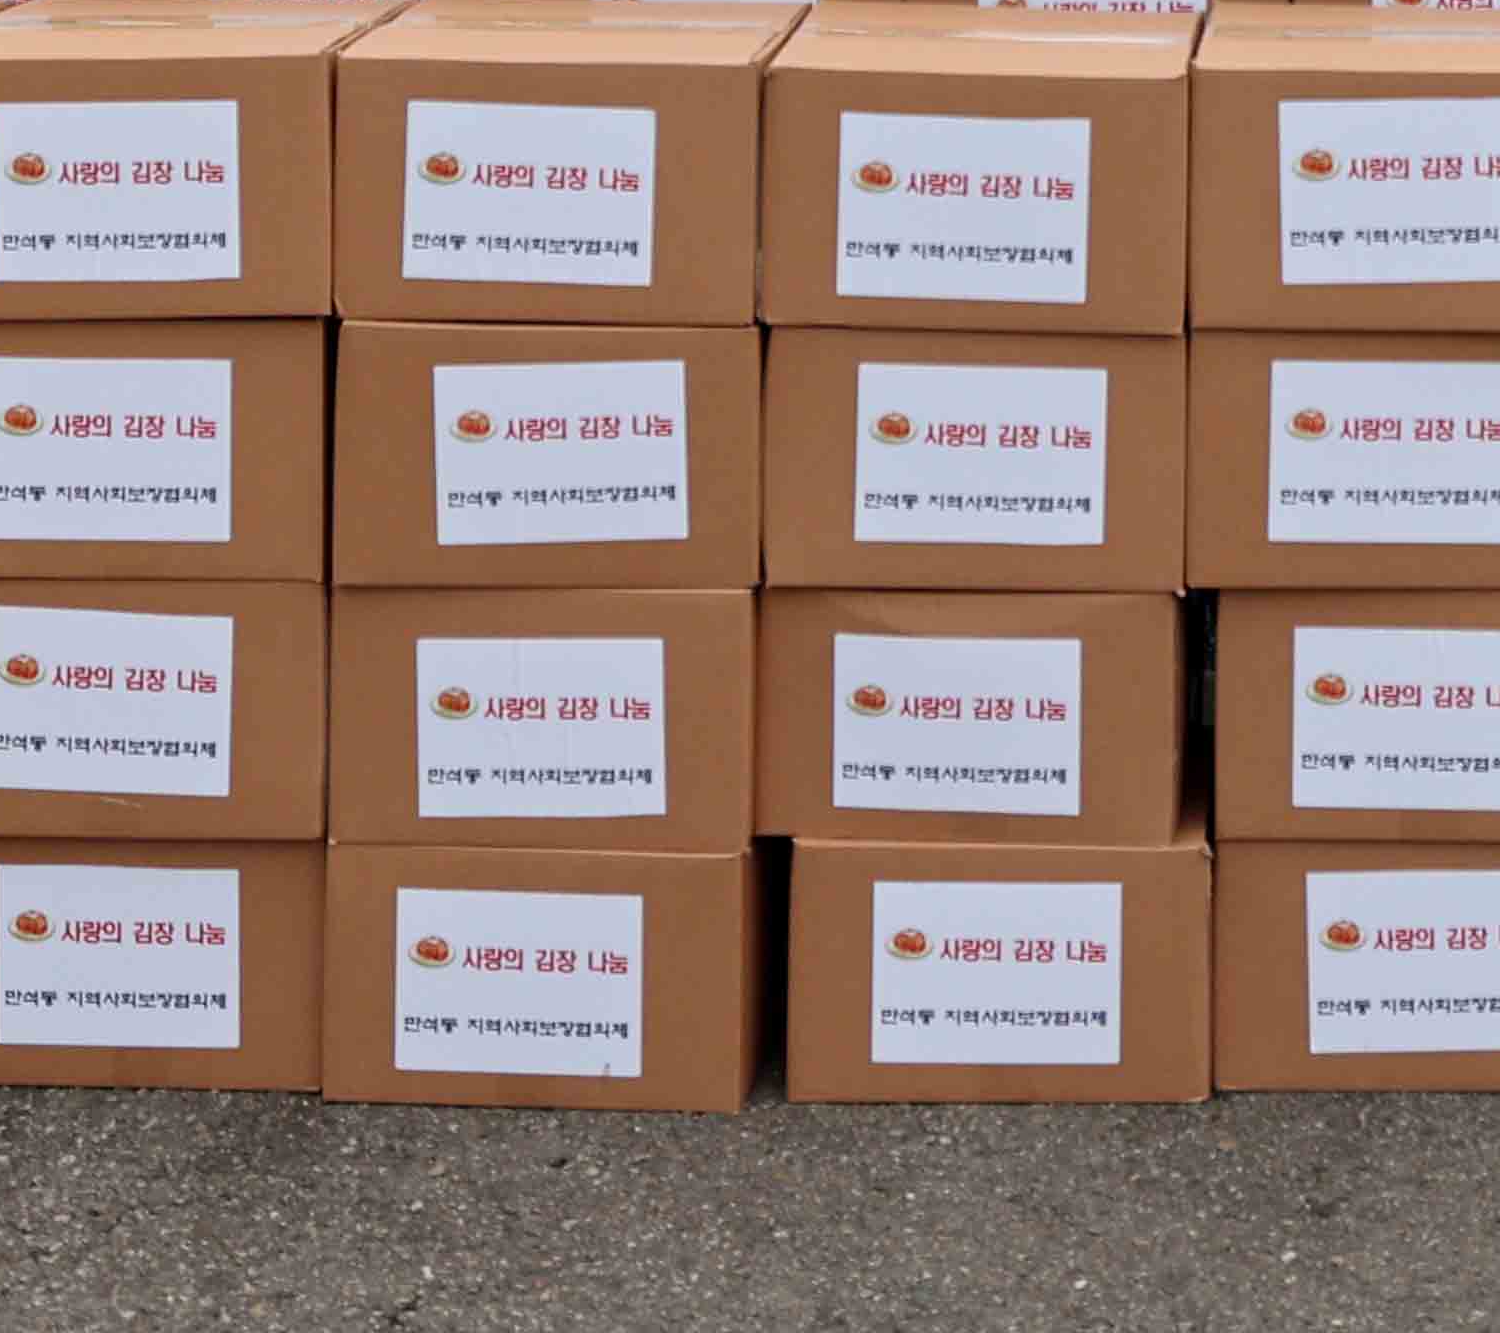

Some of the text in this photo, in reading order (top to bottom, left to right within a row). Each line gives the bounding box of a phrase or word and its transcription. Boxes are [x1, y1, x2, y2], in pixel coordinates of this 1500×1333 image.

[56, 158, 226, 187] 사랑의 김장 나눔
[904, 171, 1076, 202] 사랑의 김장 나눔
[502, 413, 675, 444] 사랑의 김장 나눔
[1338, 416, 1403, 443] 사랑의
[1412, 416, 1457, 444] 김장
[50, 663, 219, 695] 사랑의 김장 나눔
[898, 694, 1069, 723] 사랑의 김장 나눔
[1372, 926, 1437, 953] 사랑의
[1445, 925, 1490, 952] 김장
[460, 945, 630, 976] 사랑의 김장 나눔
